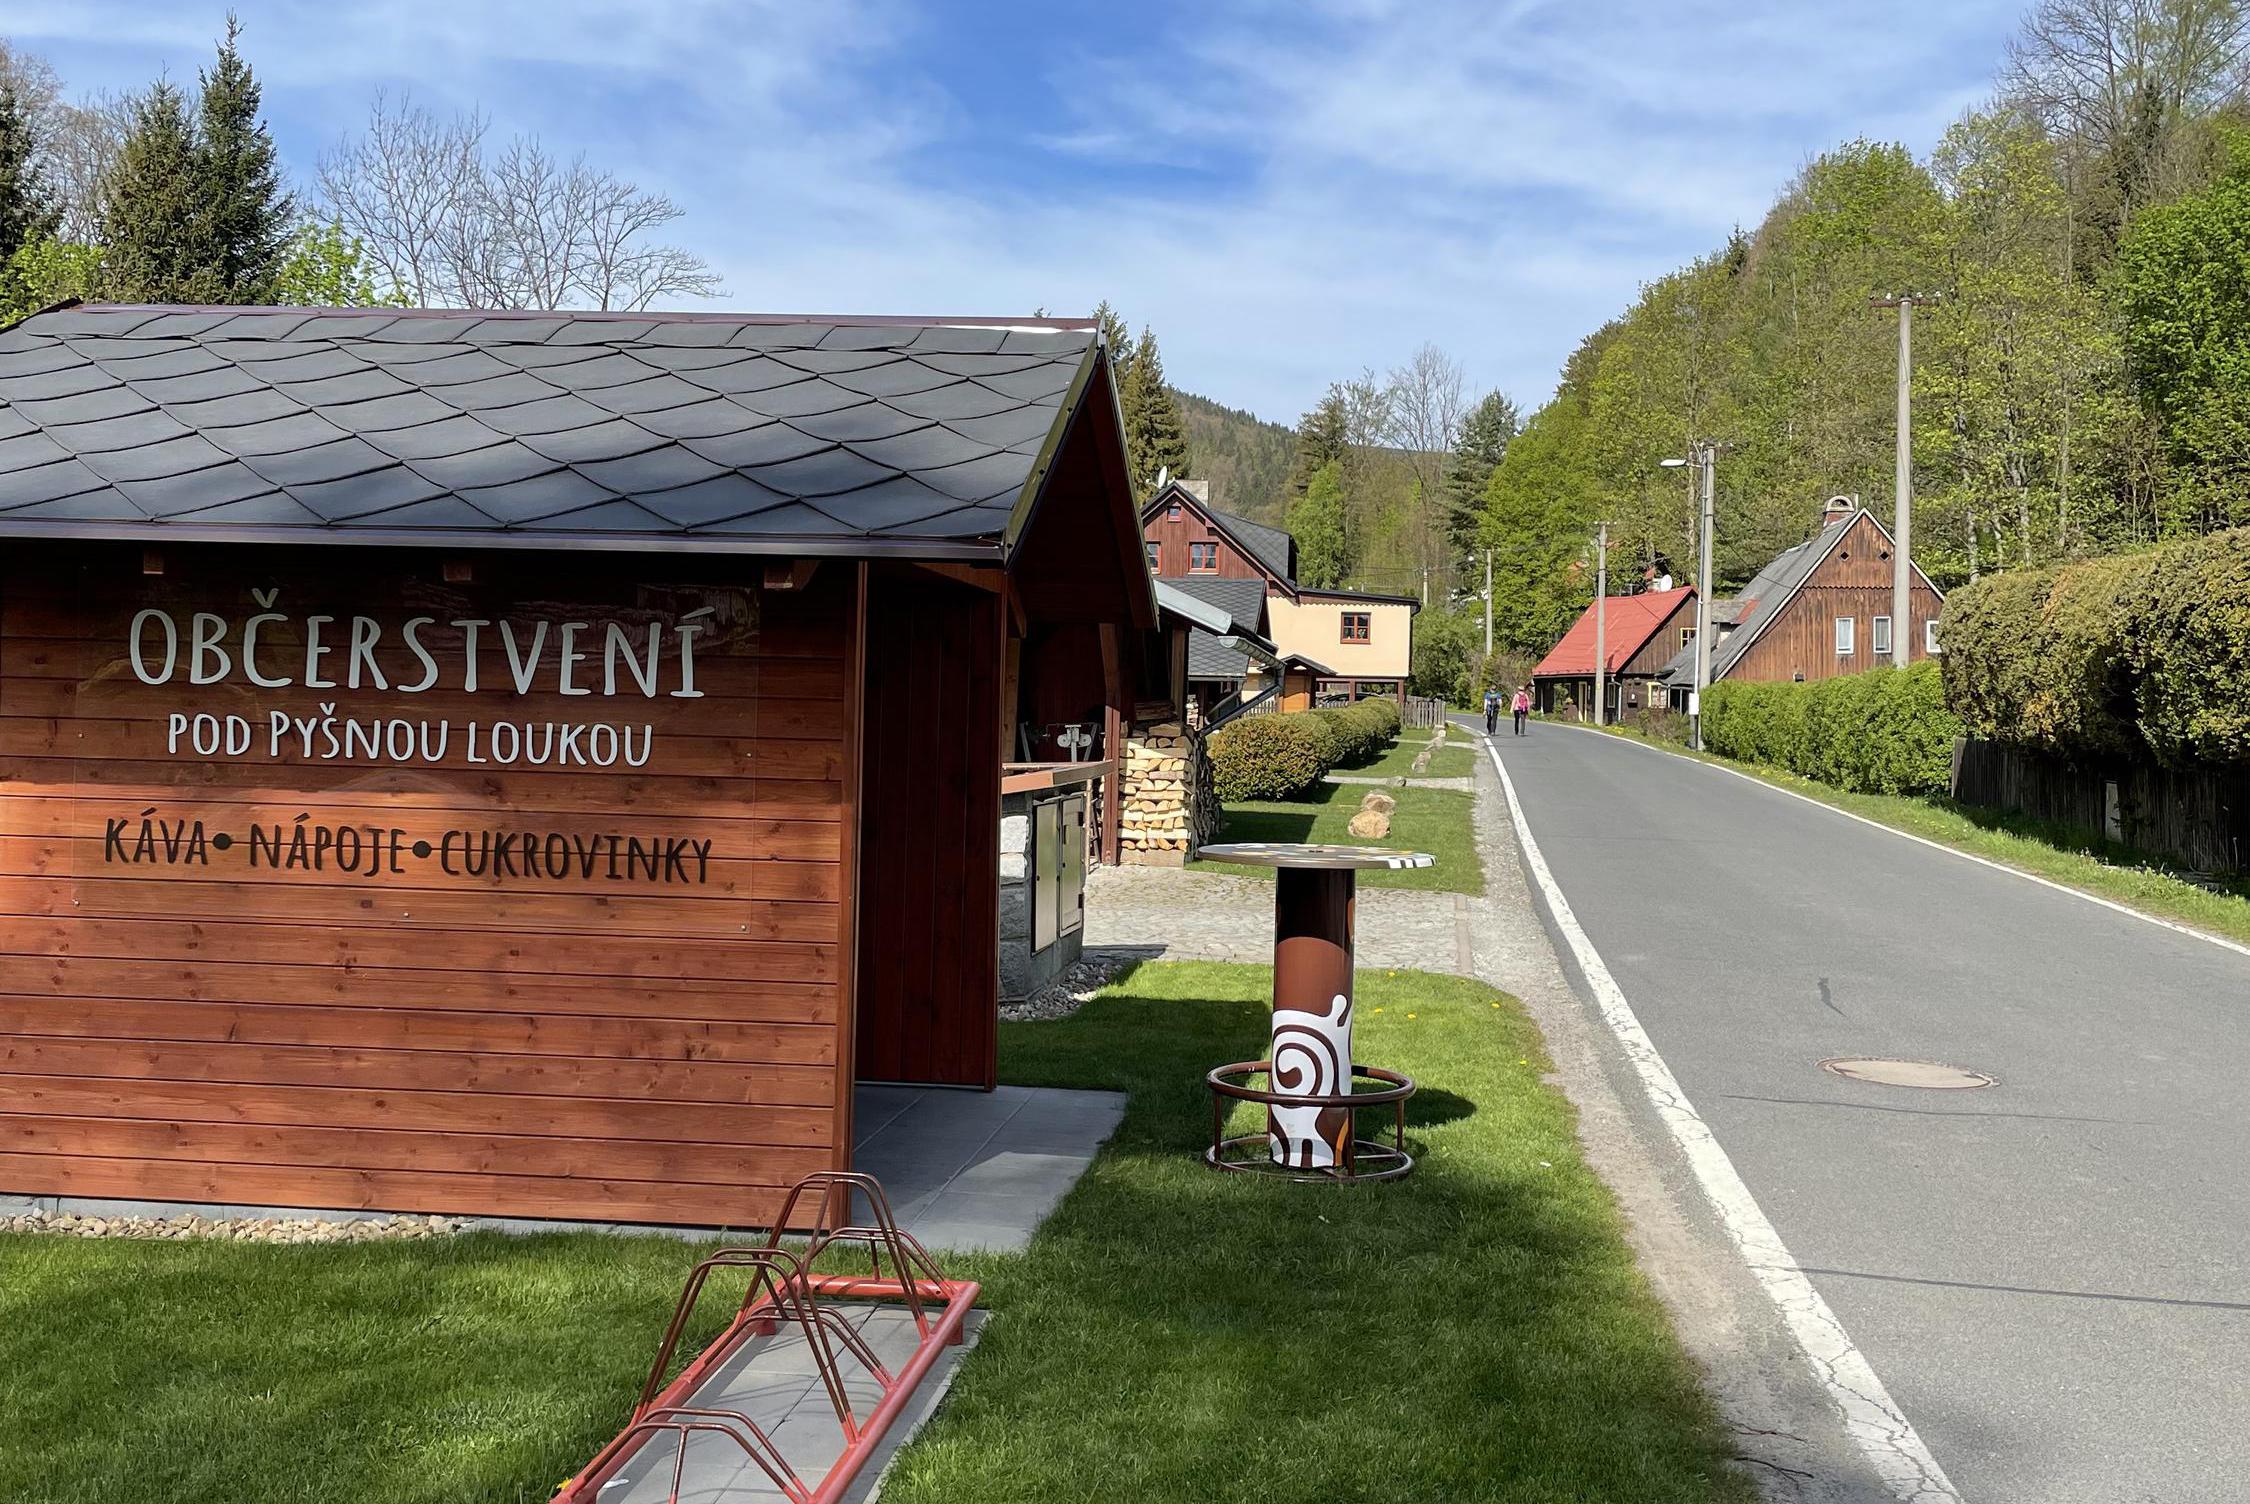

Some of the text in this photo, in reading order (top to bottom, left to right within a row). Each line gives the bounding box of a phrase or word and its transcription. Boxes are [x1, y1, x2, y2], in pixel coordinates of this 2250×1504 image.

[129, 588, 715, 698] OBČERSTVENÍ
[168, 702, 654, 767] POD PYŠNOU LOUKOU
